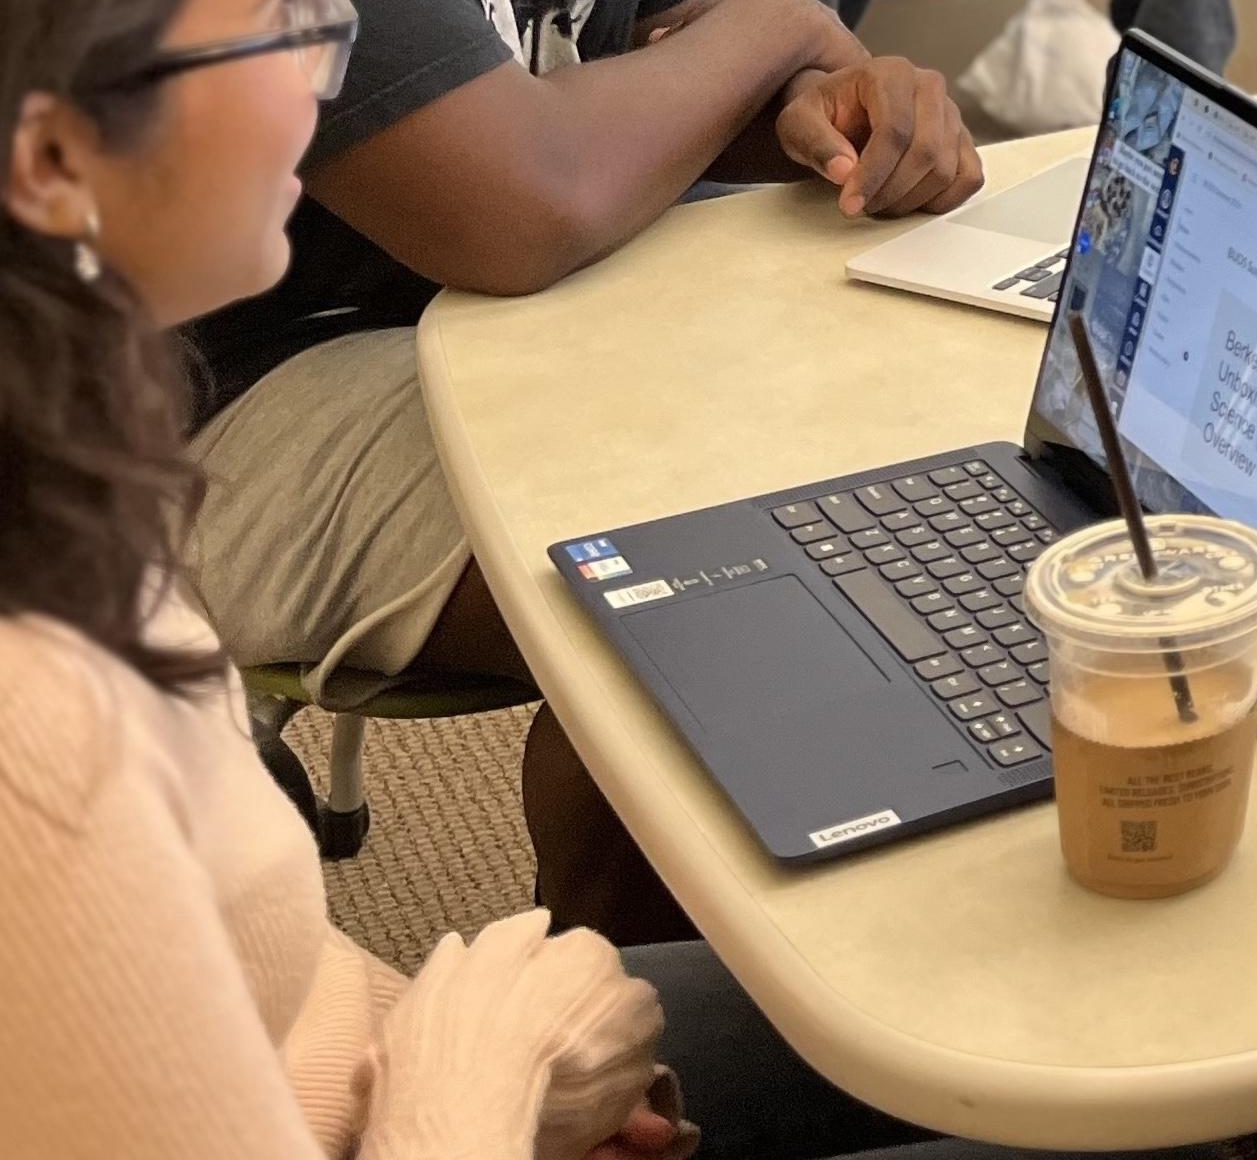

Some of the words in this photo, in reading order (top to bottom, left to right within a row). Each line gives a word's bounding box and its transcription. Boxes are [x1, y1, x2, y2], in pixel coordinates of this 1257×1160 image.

[1209, 391, 1256, 440] Science
[1202, 422, 1257, 477] Overview
[818, 816, 890, 842] Lenovo
